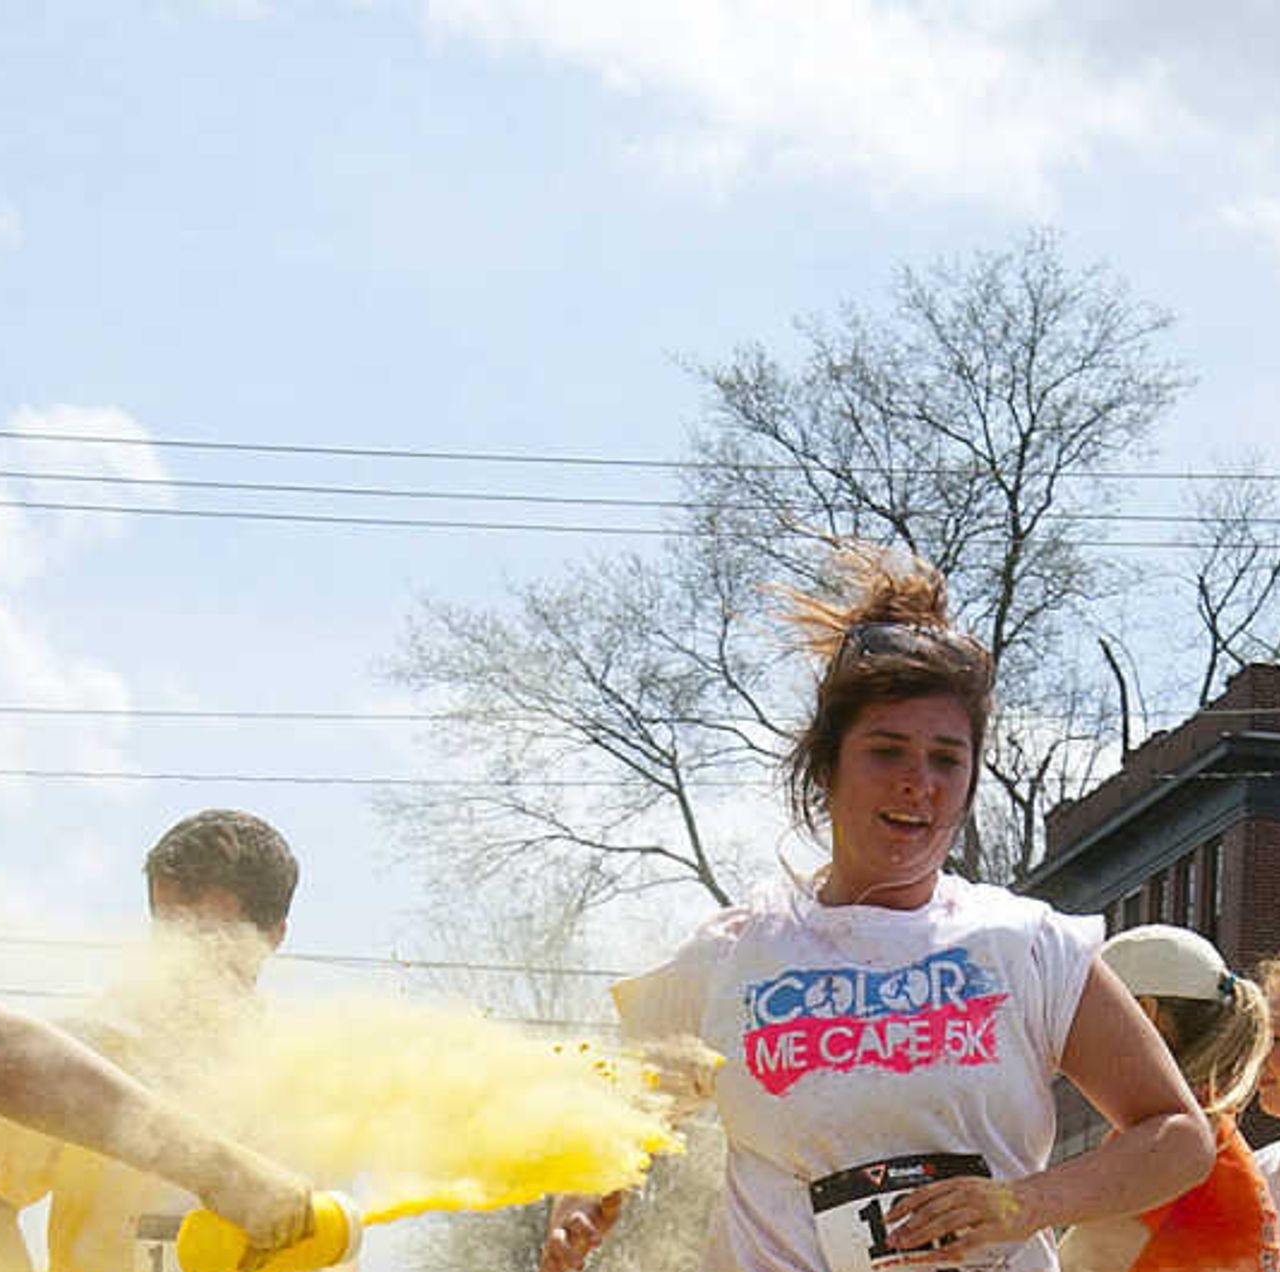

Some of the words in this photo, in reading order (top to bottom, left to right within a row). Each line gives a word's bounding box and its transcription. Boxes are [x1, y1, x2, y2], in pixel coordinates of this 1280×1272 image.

[756, 961, 967, 1025] COLOR
[756, 1033, 806, 1075] ME
[944, 1014, 995, 1059] 5K
